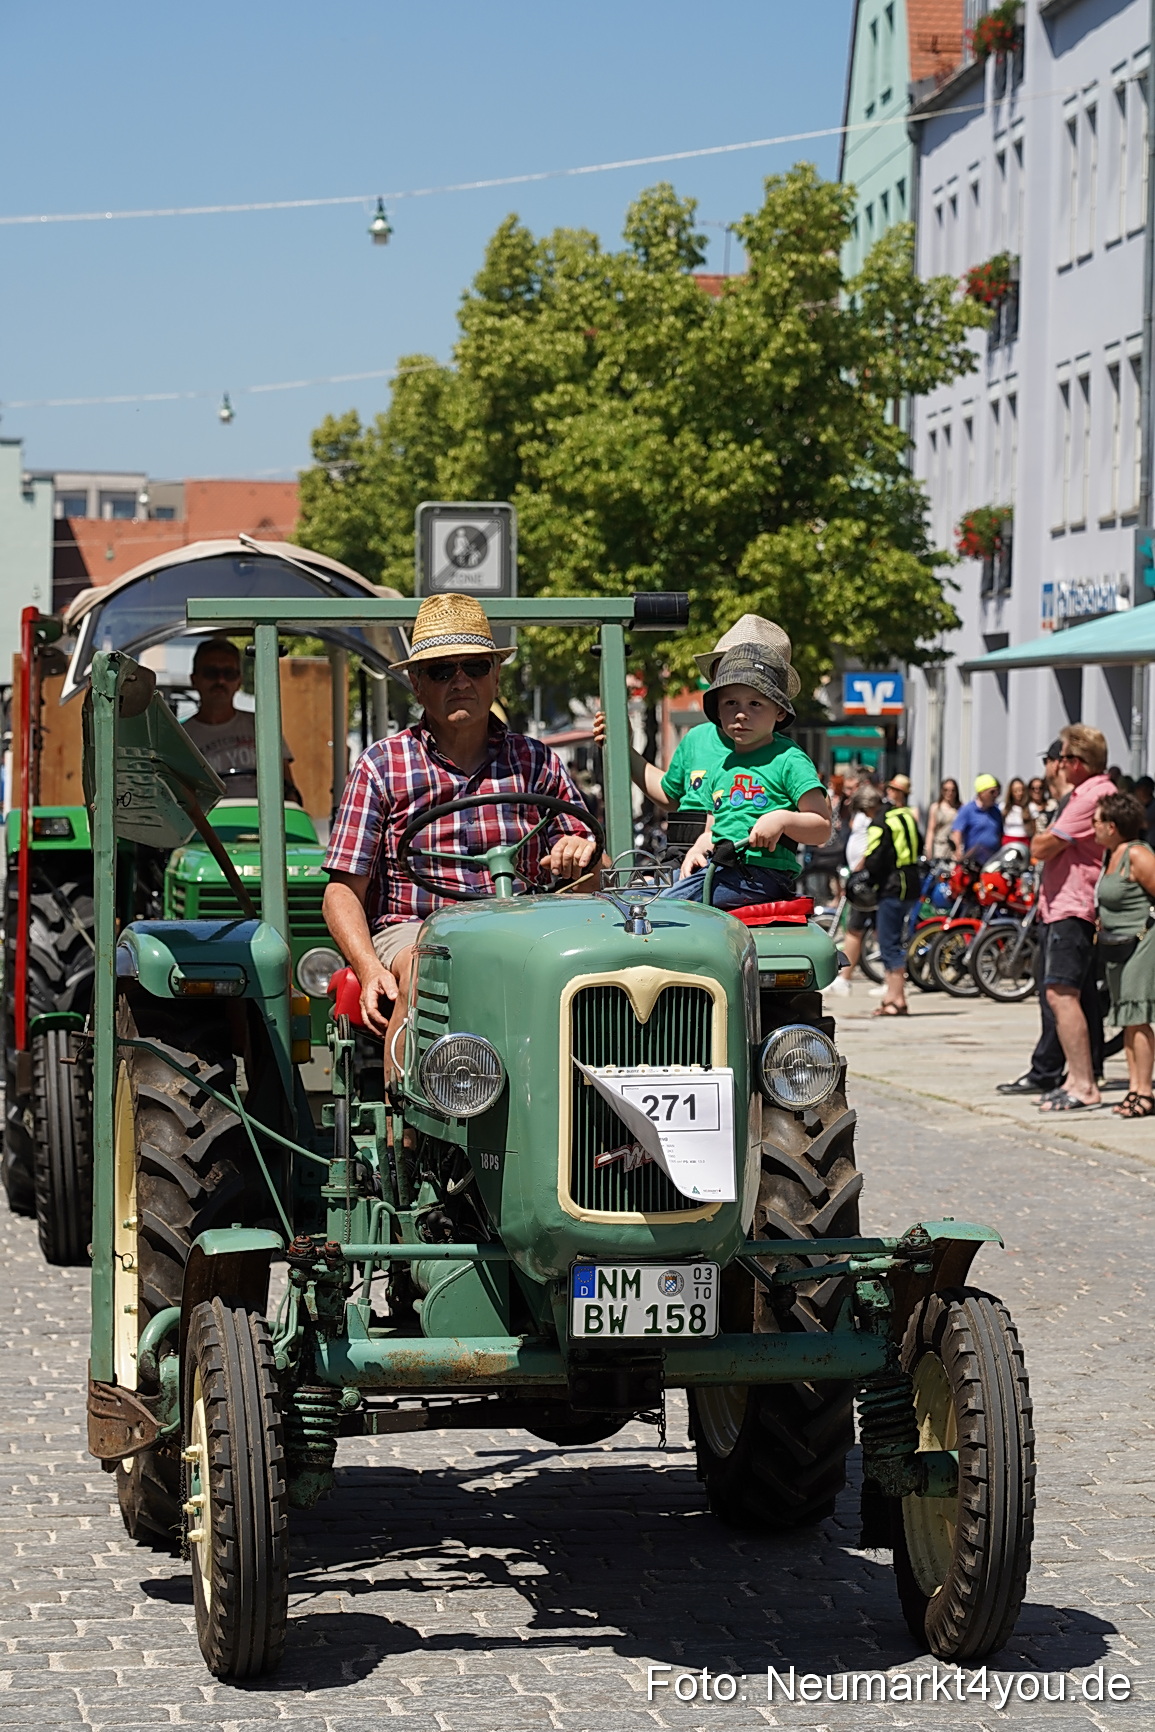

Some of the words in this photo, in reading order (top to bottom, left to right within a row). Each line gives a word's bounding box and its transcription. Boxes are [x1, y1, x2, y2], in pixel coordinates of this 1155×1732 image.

[600, 866, 673, 892] MAN
[641, 1093, 696, 1121] 271
[580, 1285, 589, 1296] D
[598, 1268, 641, 1300] NM
[693, 1267, 712, 1280] 03
[694, 1286, 712, 1300] 10
[584, 1304, 628, 1334] BW
[643, 1303, 707, 1334] 158
